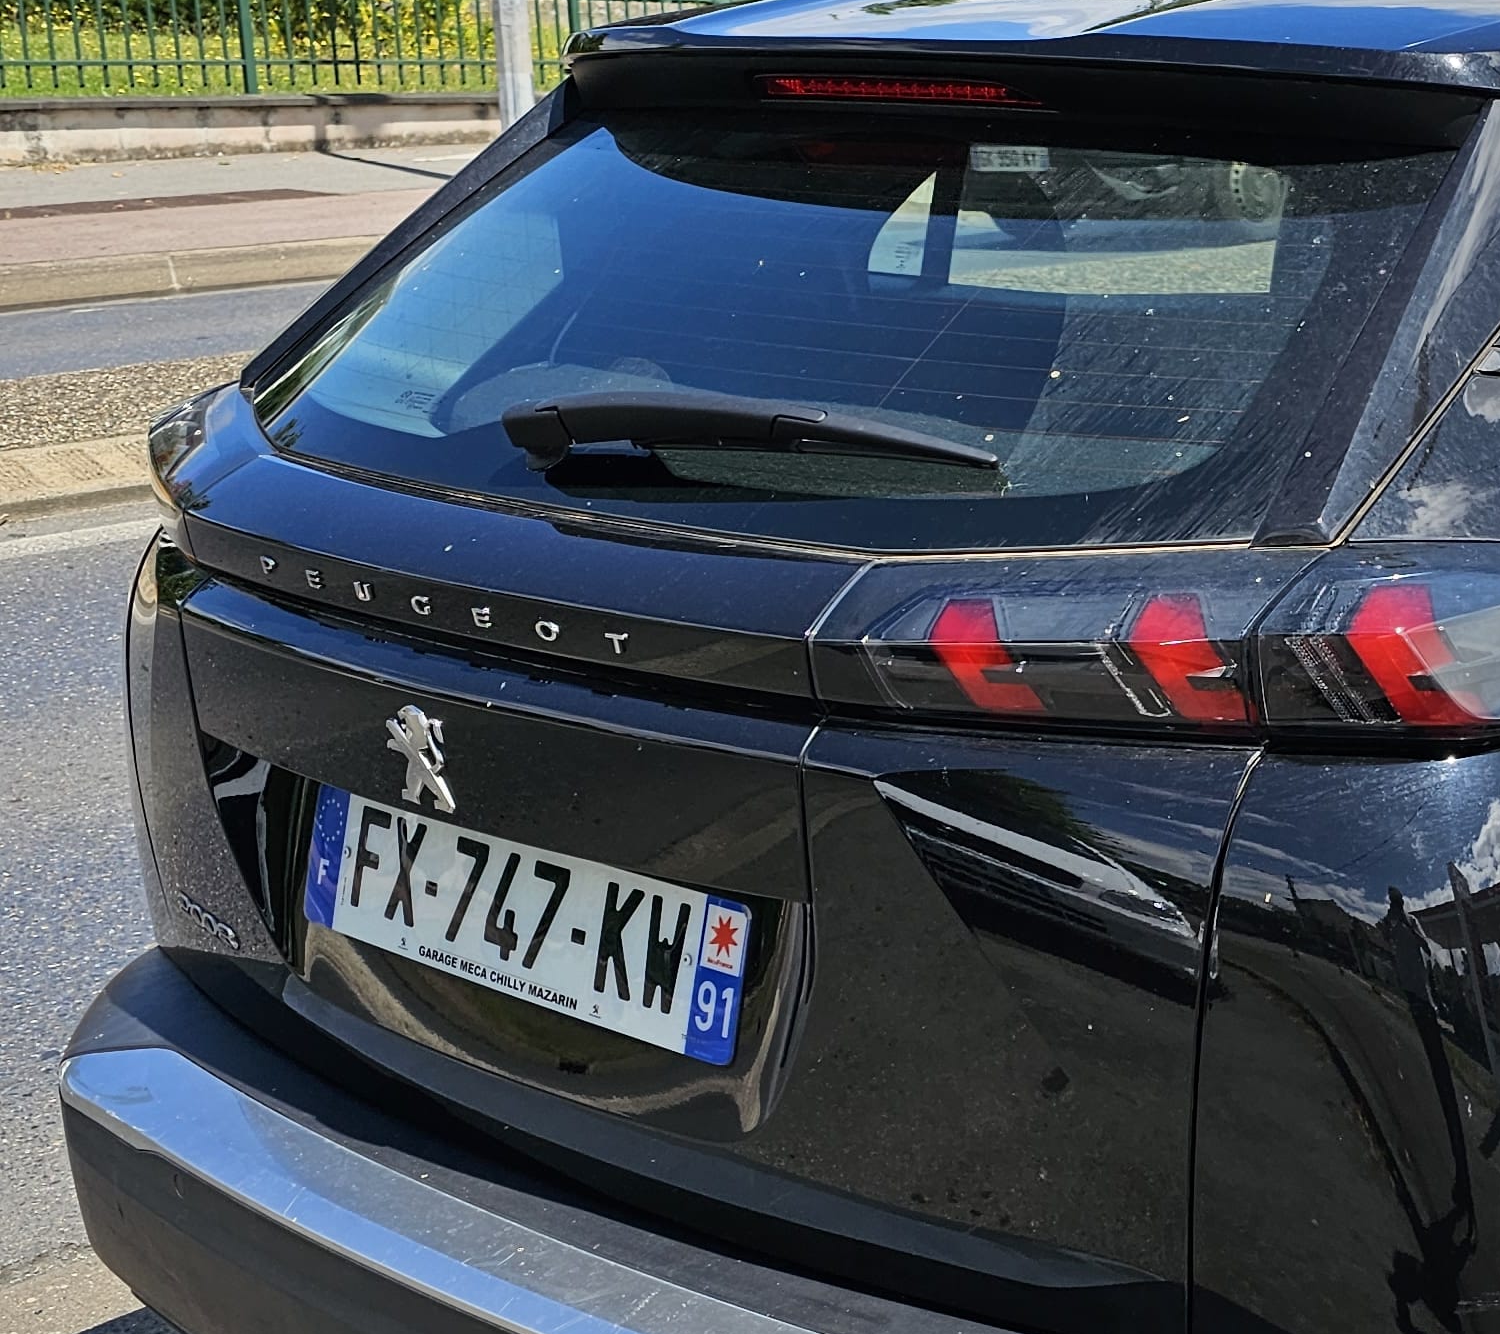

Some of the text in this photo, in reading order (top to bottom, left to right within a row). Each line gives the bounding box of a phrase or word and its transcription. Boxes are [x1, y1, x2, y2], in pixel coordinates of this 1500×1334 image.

[259, 554, 629, 655] PEUGEOT
[316, 857, 330, 885] F
[350, 805, 692, 1015] FX-747-KW
[418, 945, 578, 1011] GARAGE MECA CHILLY MAZARIN
[694, 980, 735, 1039] 91
